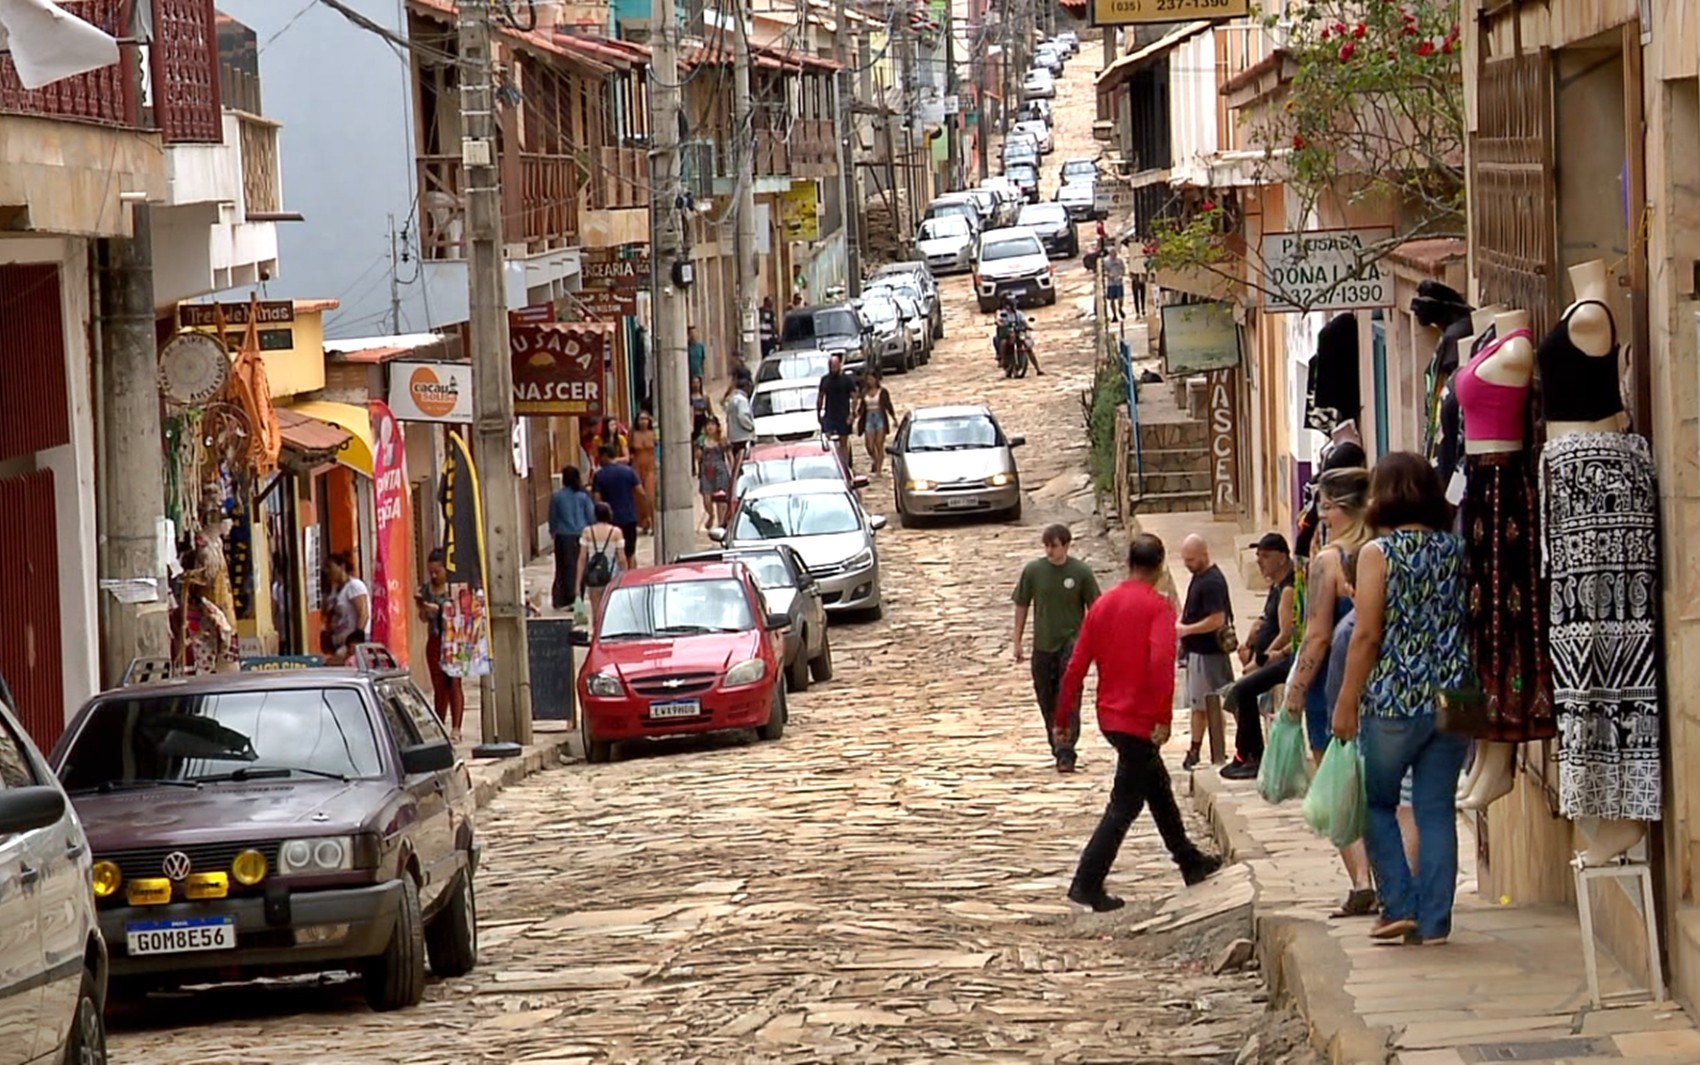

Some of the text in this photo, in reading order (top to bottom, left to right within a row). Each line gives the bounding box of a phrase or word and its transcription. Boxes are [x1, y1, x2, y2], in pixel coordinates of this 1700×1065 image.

[1282, 235, 1362, 254] PUSADA
[581, 262, 634, 278] ERCEARIA
[189, 307, 217, 326] Tre
[511, 332, 592, 370] USADA
[414, 384, 449, 393] cacau
[513, 382, 599, 400] NASCER
[138, 928, 225, 951] GOM8E56
